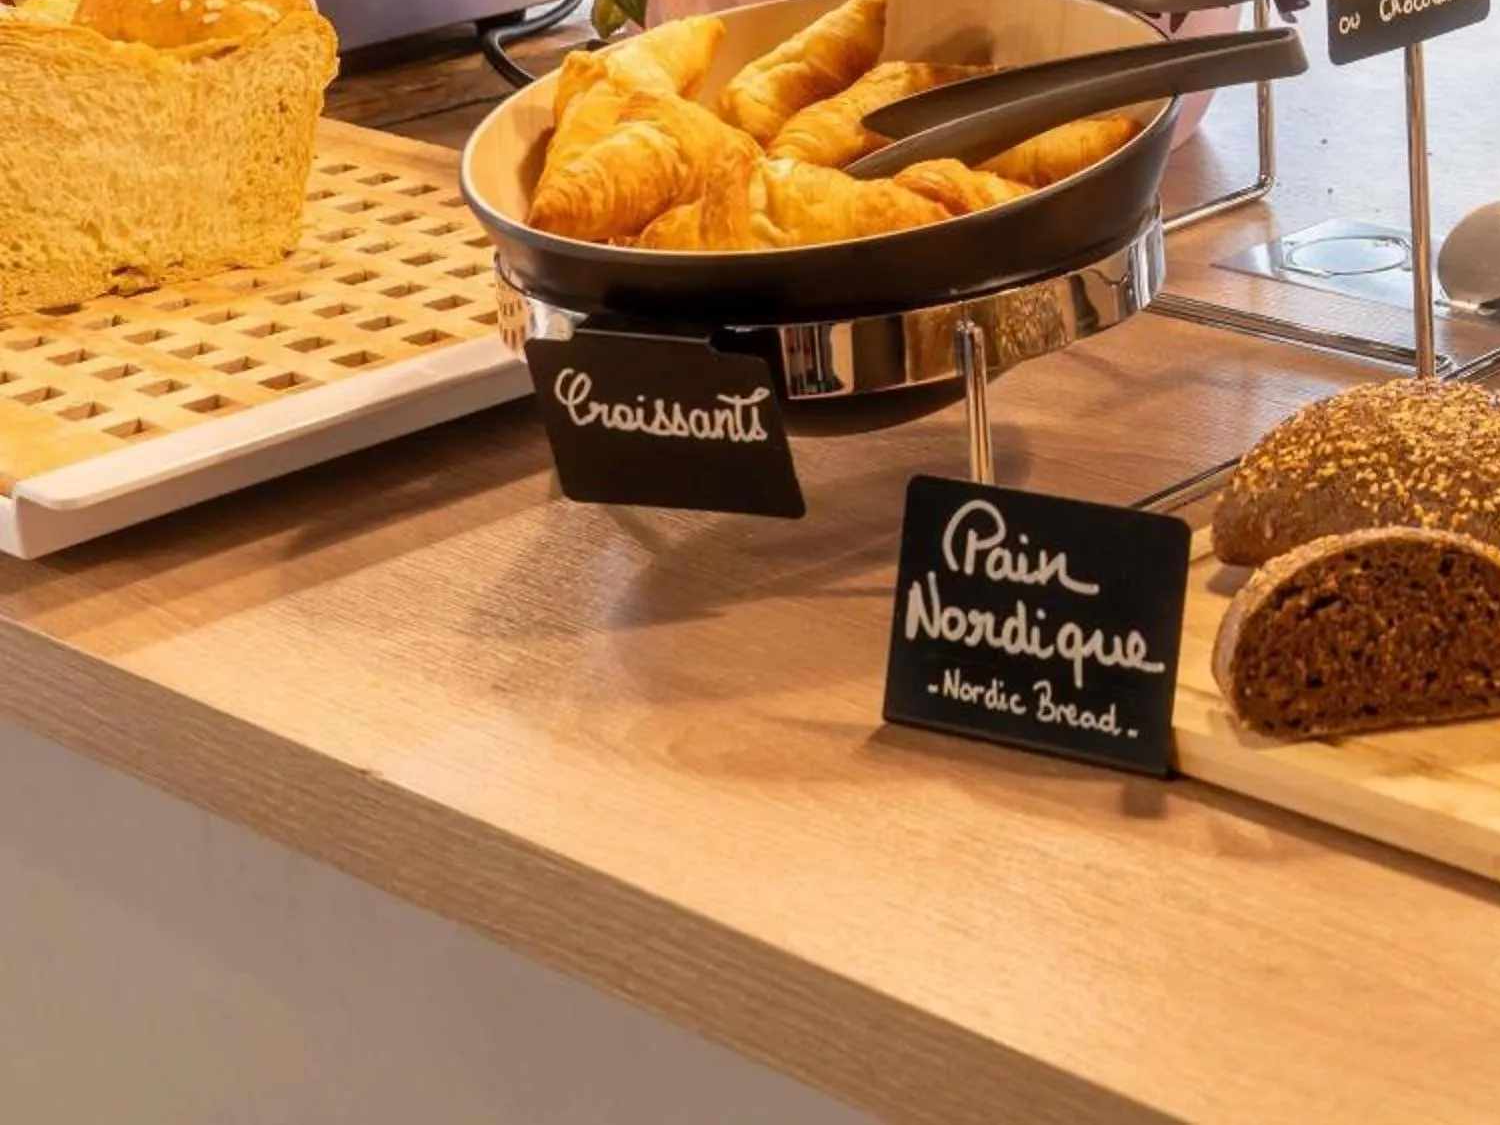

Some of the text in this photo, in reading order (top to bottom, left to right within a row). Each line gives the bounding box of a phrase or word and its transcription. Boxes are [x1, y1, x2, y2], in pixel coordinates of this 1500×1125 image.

[553, 367, 770, 442] Croissants
[942, 499, 1100, 595] Pain
[905, 570, 1166, 688] Nordique
